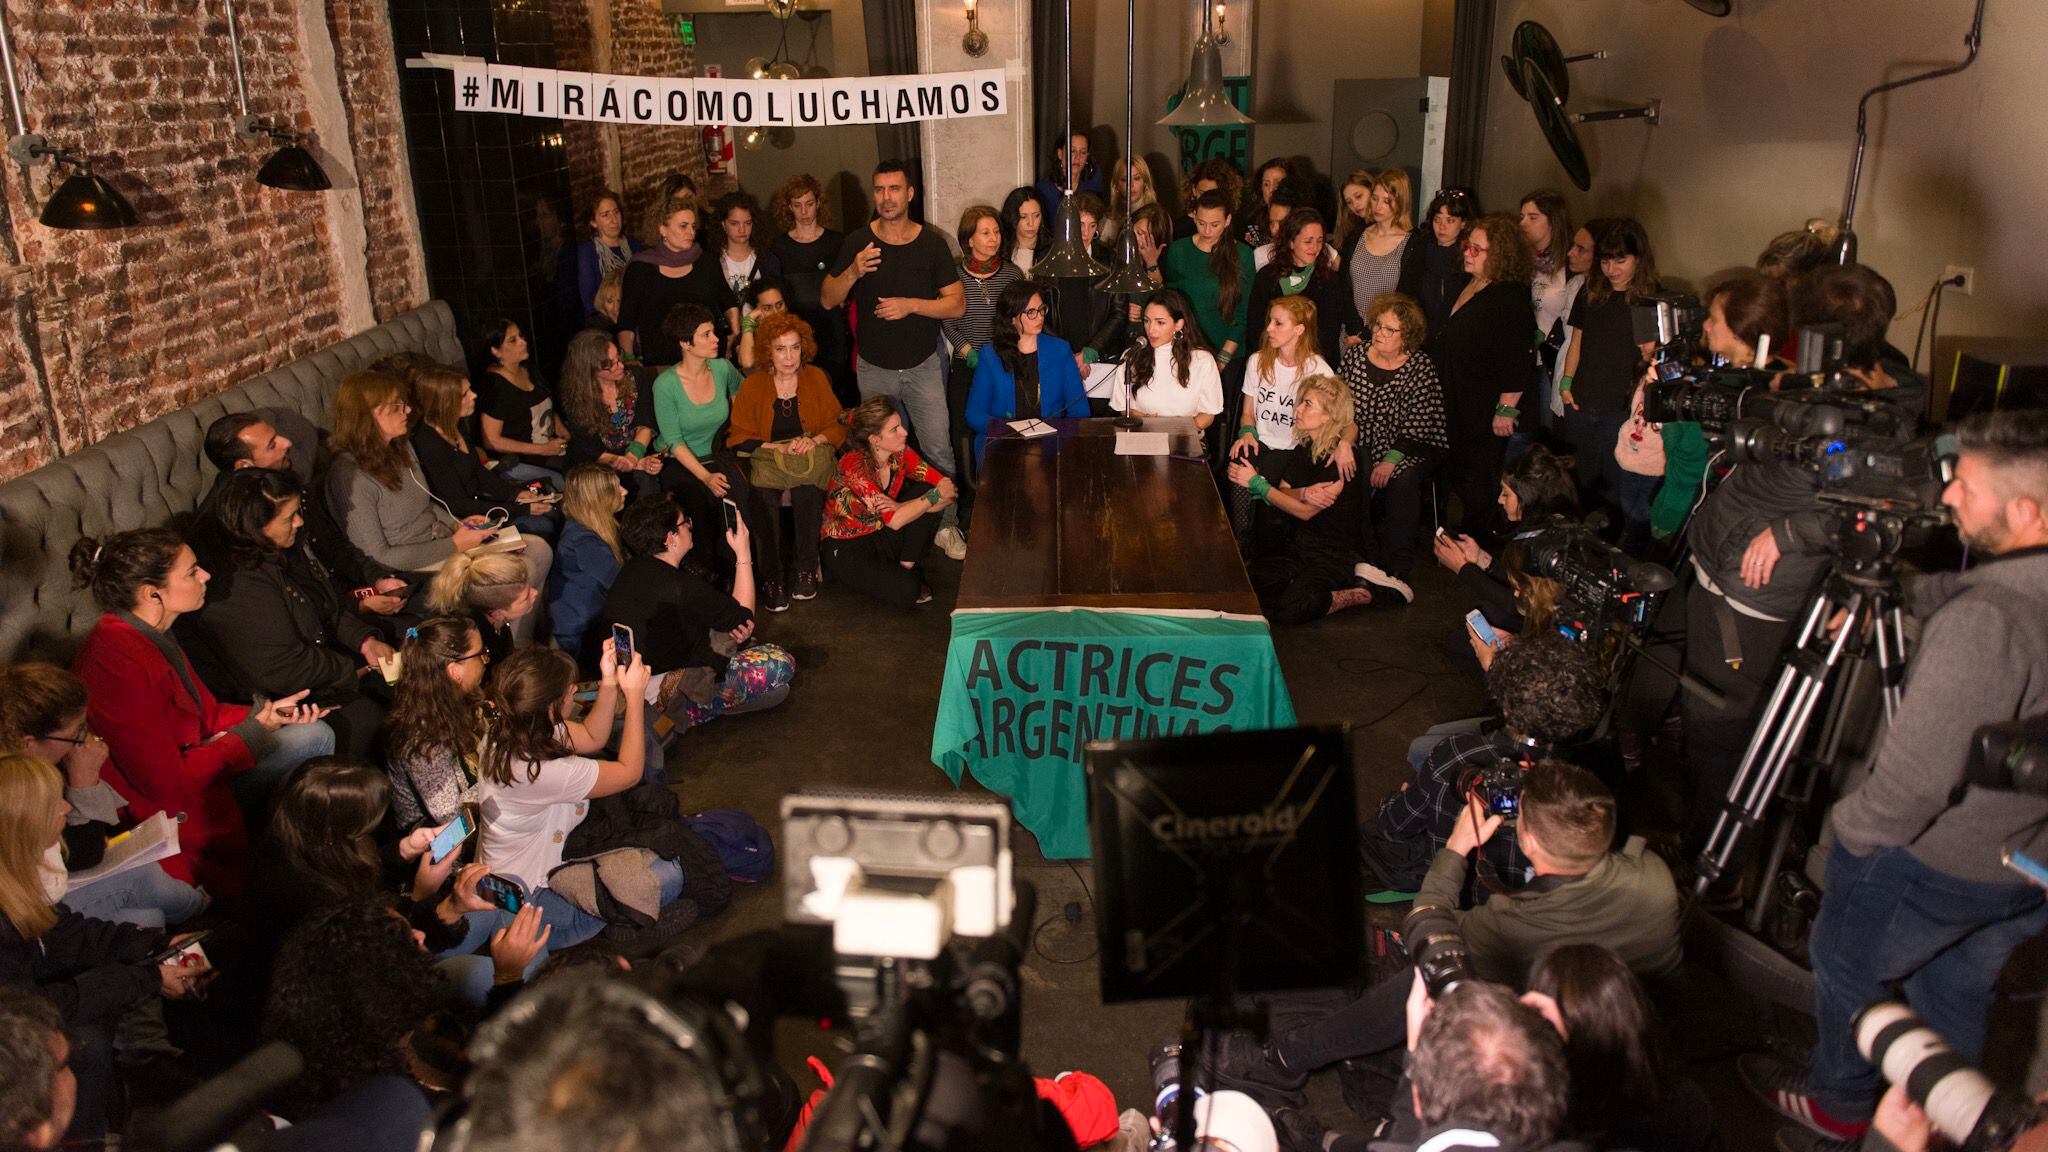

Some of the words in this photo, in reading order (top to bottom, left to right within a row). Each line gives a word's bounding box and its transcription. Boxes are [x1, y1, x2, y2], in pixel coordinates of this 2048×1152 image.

[1258, 386, 1276, 404] SE
[1279, 394, 1295, 408] VA
[966, 639, 1240, 716] ACTRICES
[1150, 806, 1297, 840] Cineroid
